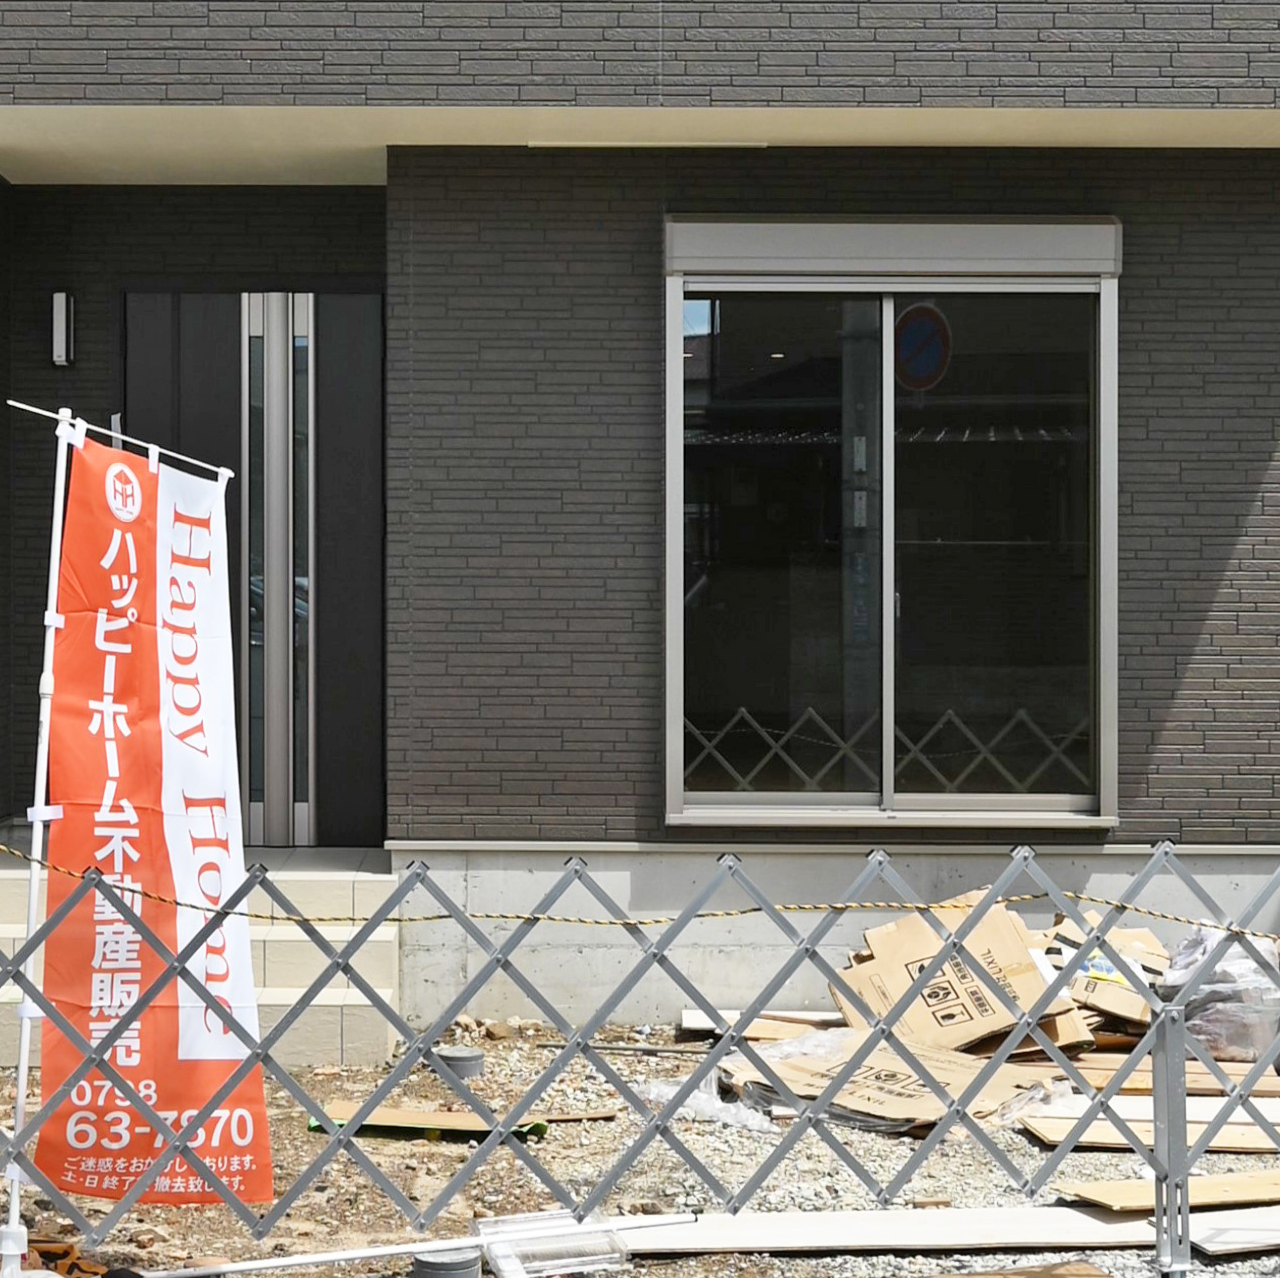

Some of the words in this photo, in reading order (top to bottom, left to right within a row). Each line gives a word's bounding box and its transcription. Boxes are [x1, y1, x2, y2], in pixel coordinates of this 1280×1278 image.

[161, 502, 212, 758] Happy
[64, 1154, 257, 1173] ご迷惑をおかしおります。
[61, 1170, 245, 1193] 土・日終了撤去致しす。
